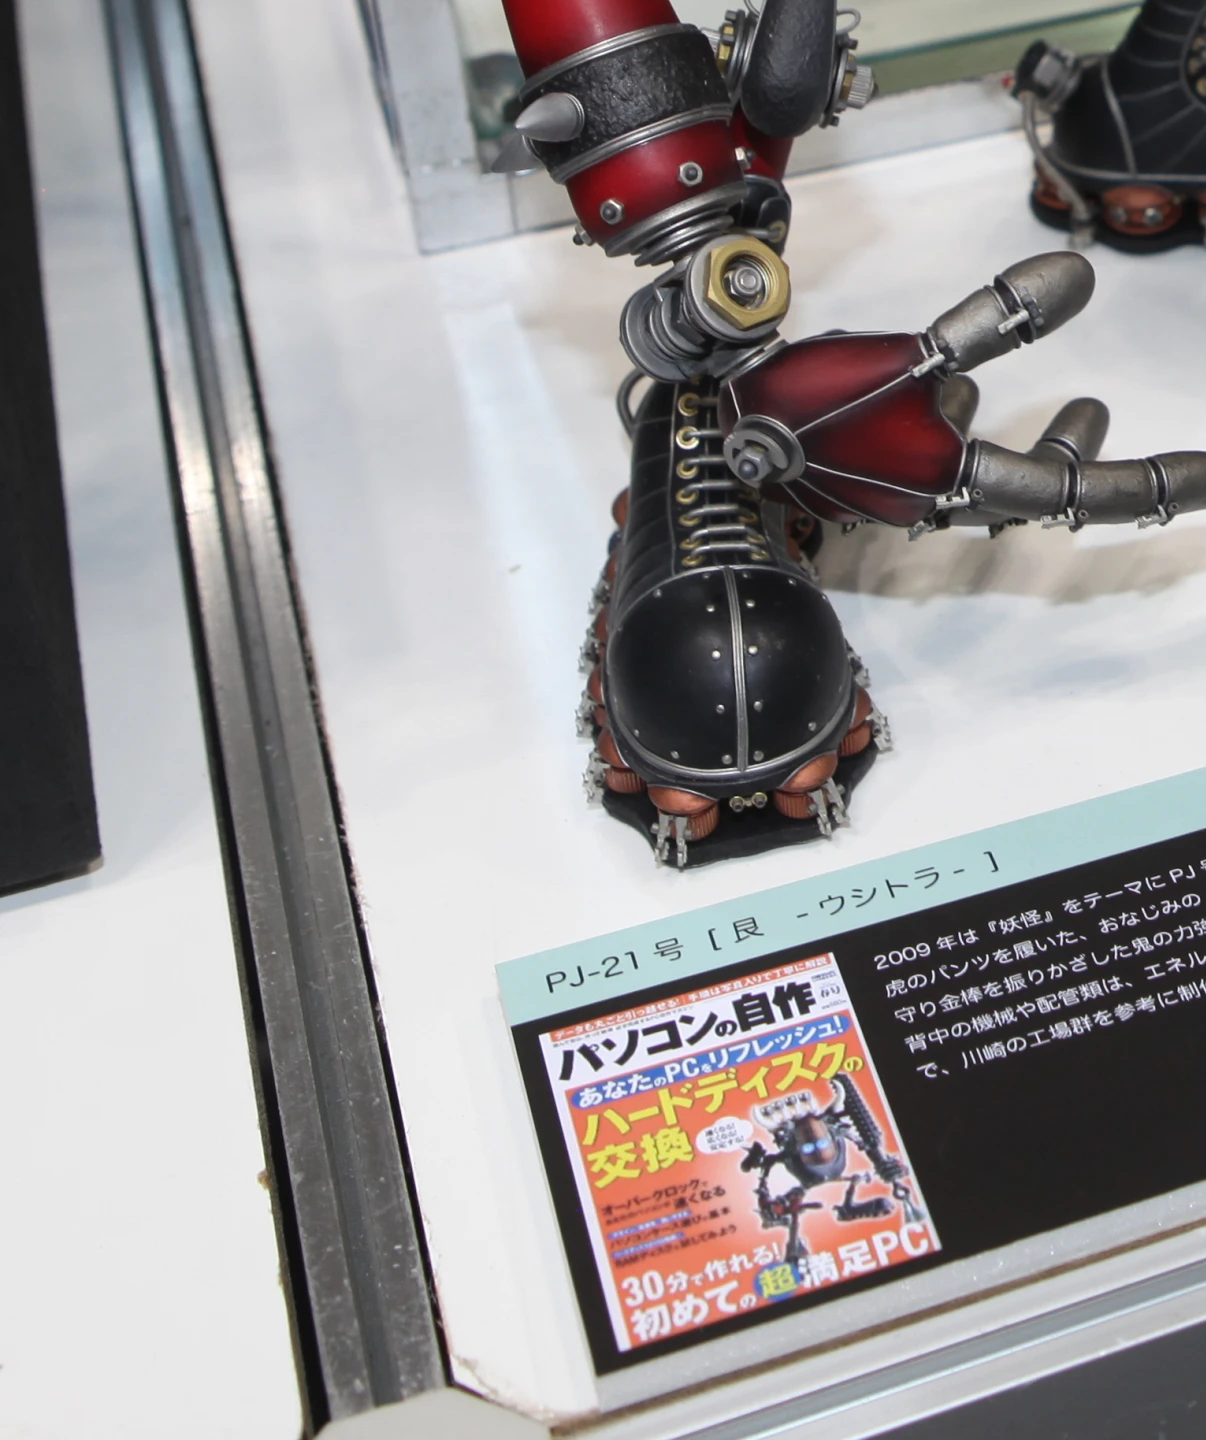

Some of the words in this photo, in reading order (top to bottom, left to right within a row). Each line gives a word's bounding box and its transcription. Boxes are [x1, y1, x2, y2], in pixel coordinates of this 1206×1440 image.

[559, 982, 815, 1080] パソコンの自作
[582, 1042, 862, 1147] ハードディスクの
[587, 1122, 693, 1188] 交換
[620, 1238, 783, 1309] 30分で作れる!
